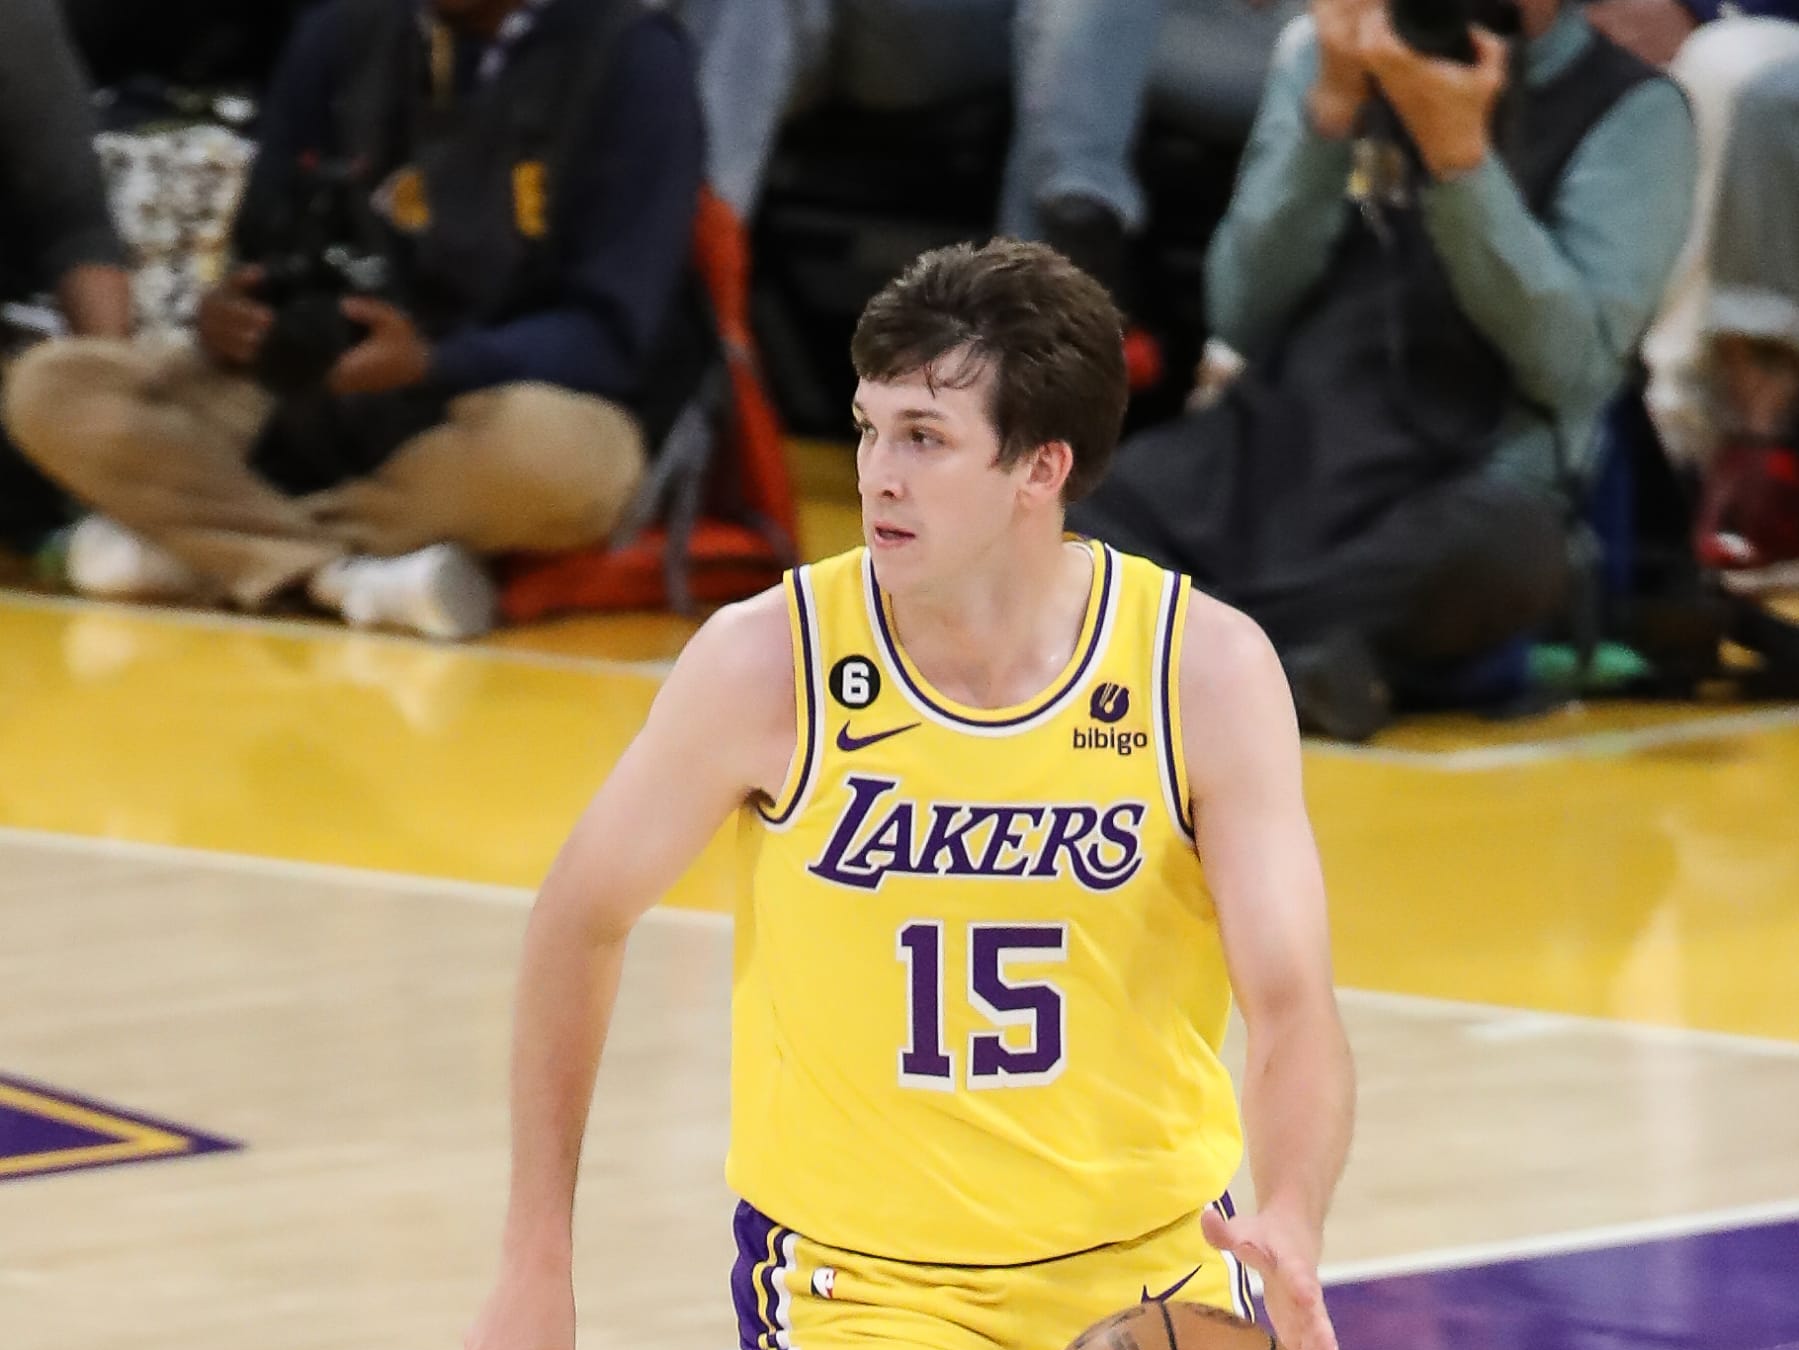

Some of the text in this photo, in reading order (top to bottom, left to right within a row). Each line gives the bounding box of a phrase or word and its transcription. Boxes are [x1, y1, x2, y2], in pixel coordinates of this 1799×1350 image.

[842, 661, 870, 704] 6
[1073, 727, 1147, 756] bibigo
[806, 773, 1147, 891] LAKERS
[896, 919, 1068, 1091] 15
